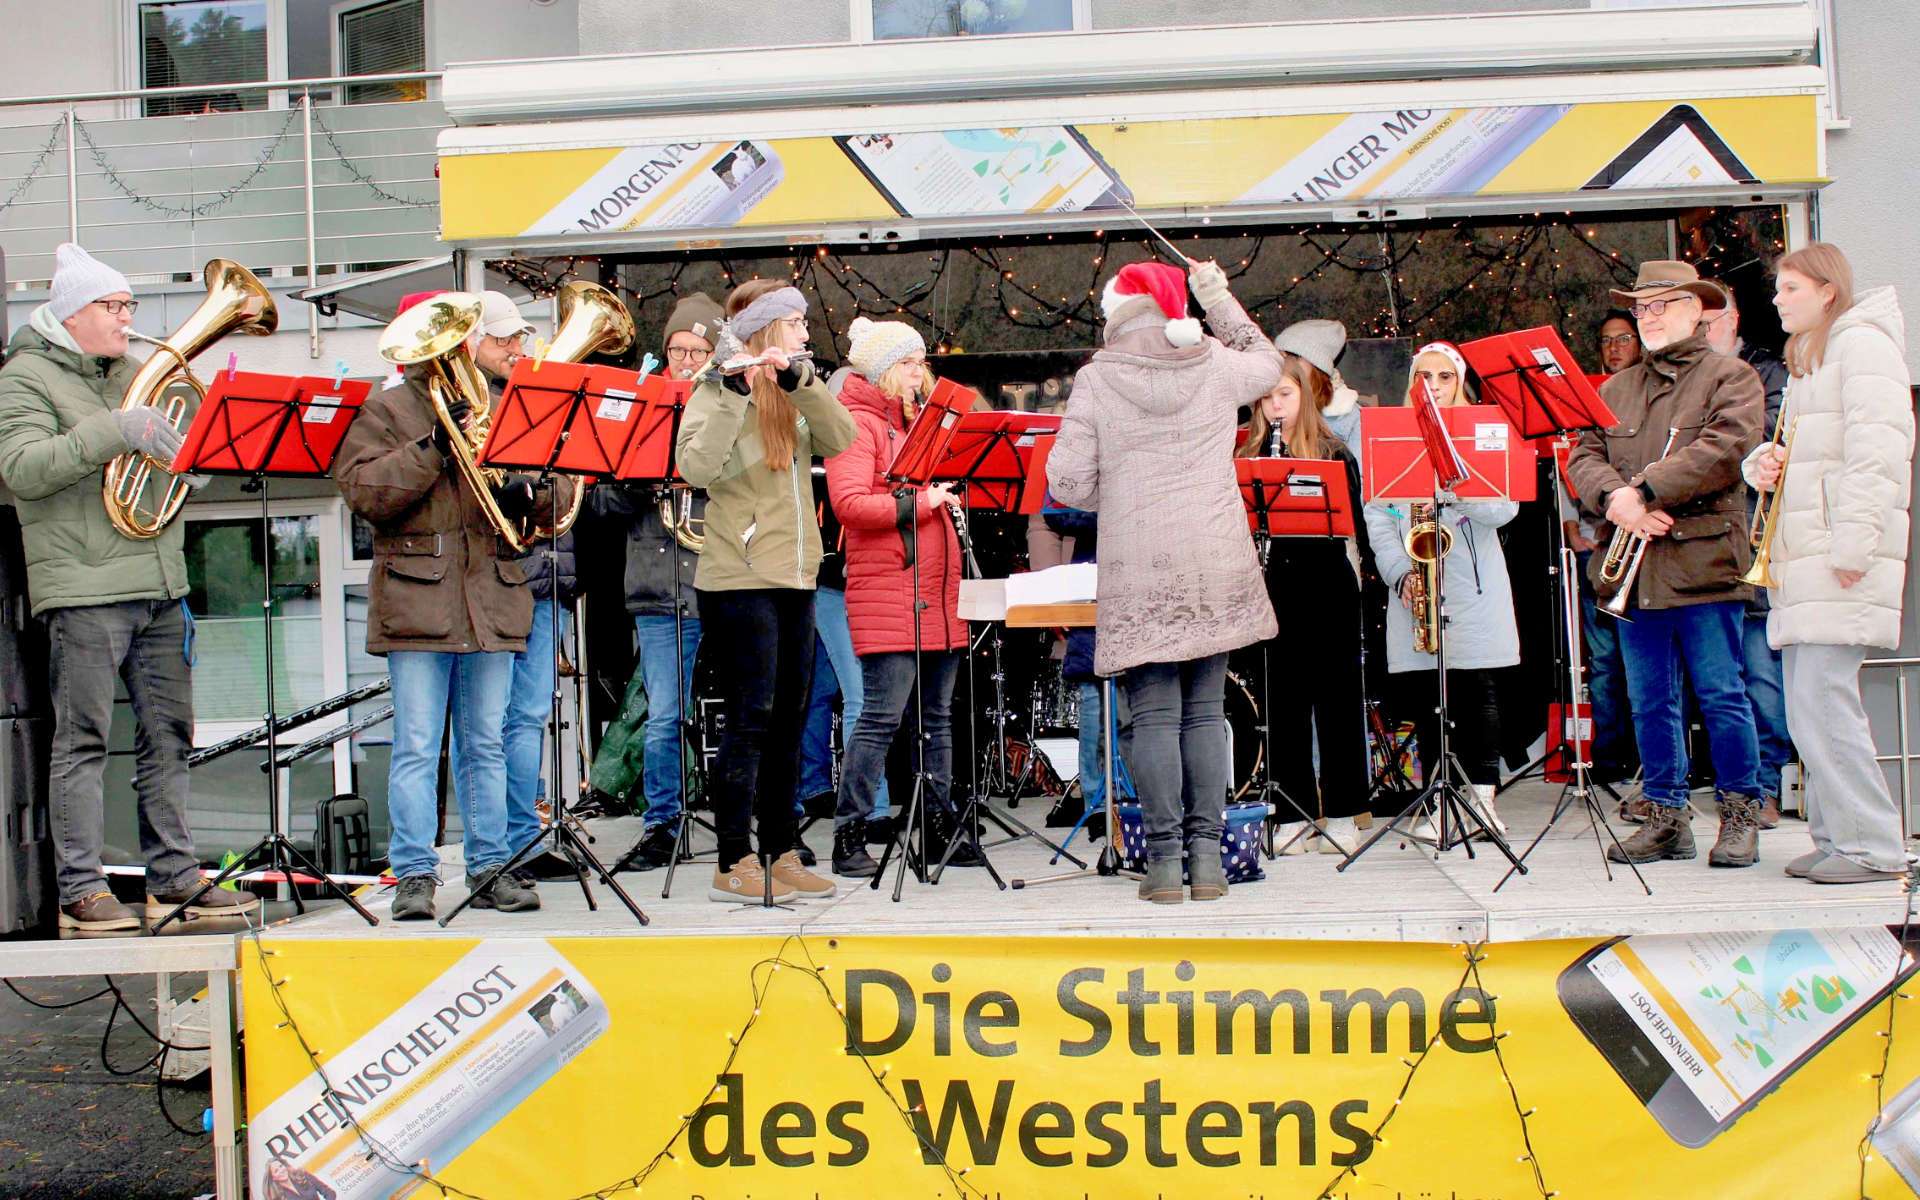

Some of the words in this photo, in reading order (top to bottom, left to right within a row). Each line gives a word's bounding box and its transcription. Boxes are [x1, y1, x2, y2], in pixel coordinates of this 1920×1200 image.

[1436, 116, 1452, 131] POST
[843, 963, 1020, 1056] Die
[1058, 960, 1498, 1055] Stimme
[1628, 989, 1657, 1021] POST
[264, 1021, 447, 1161] RHEINISCHE
[433, 964, 519, 1038] POST
[1650, 1017, 1704, 1077] RHEINISCHE
[689, 1073, 869, 1167] des
[902, 1079, 1374, 1168] Westens
